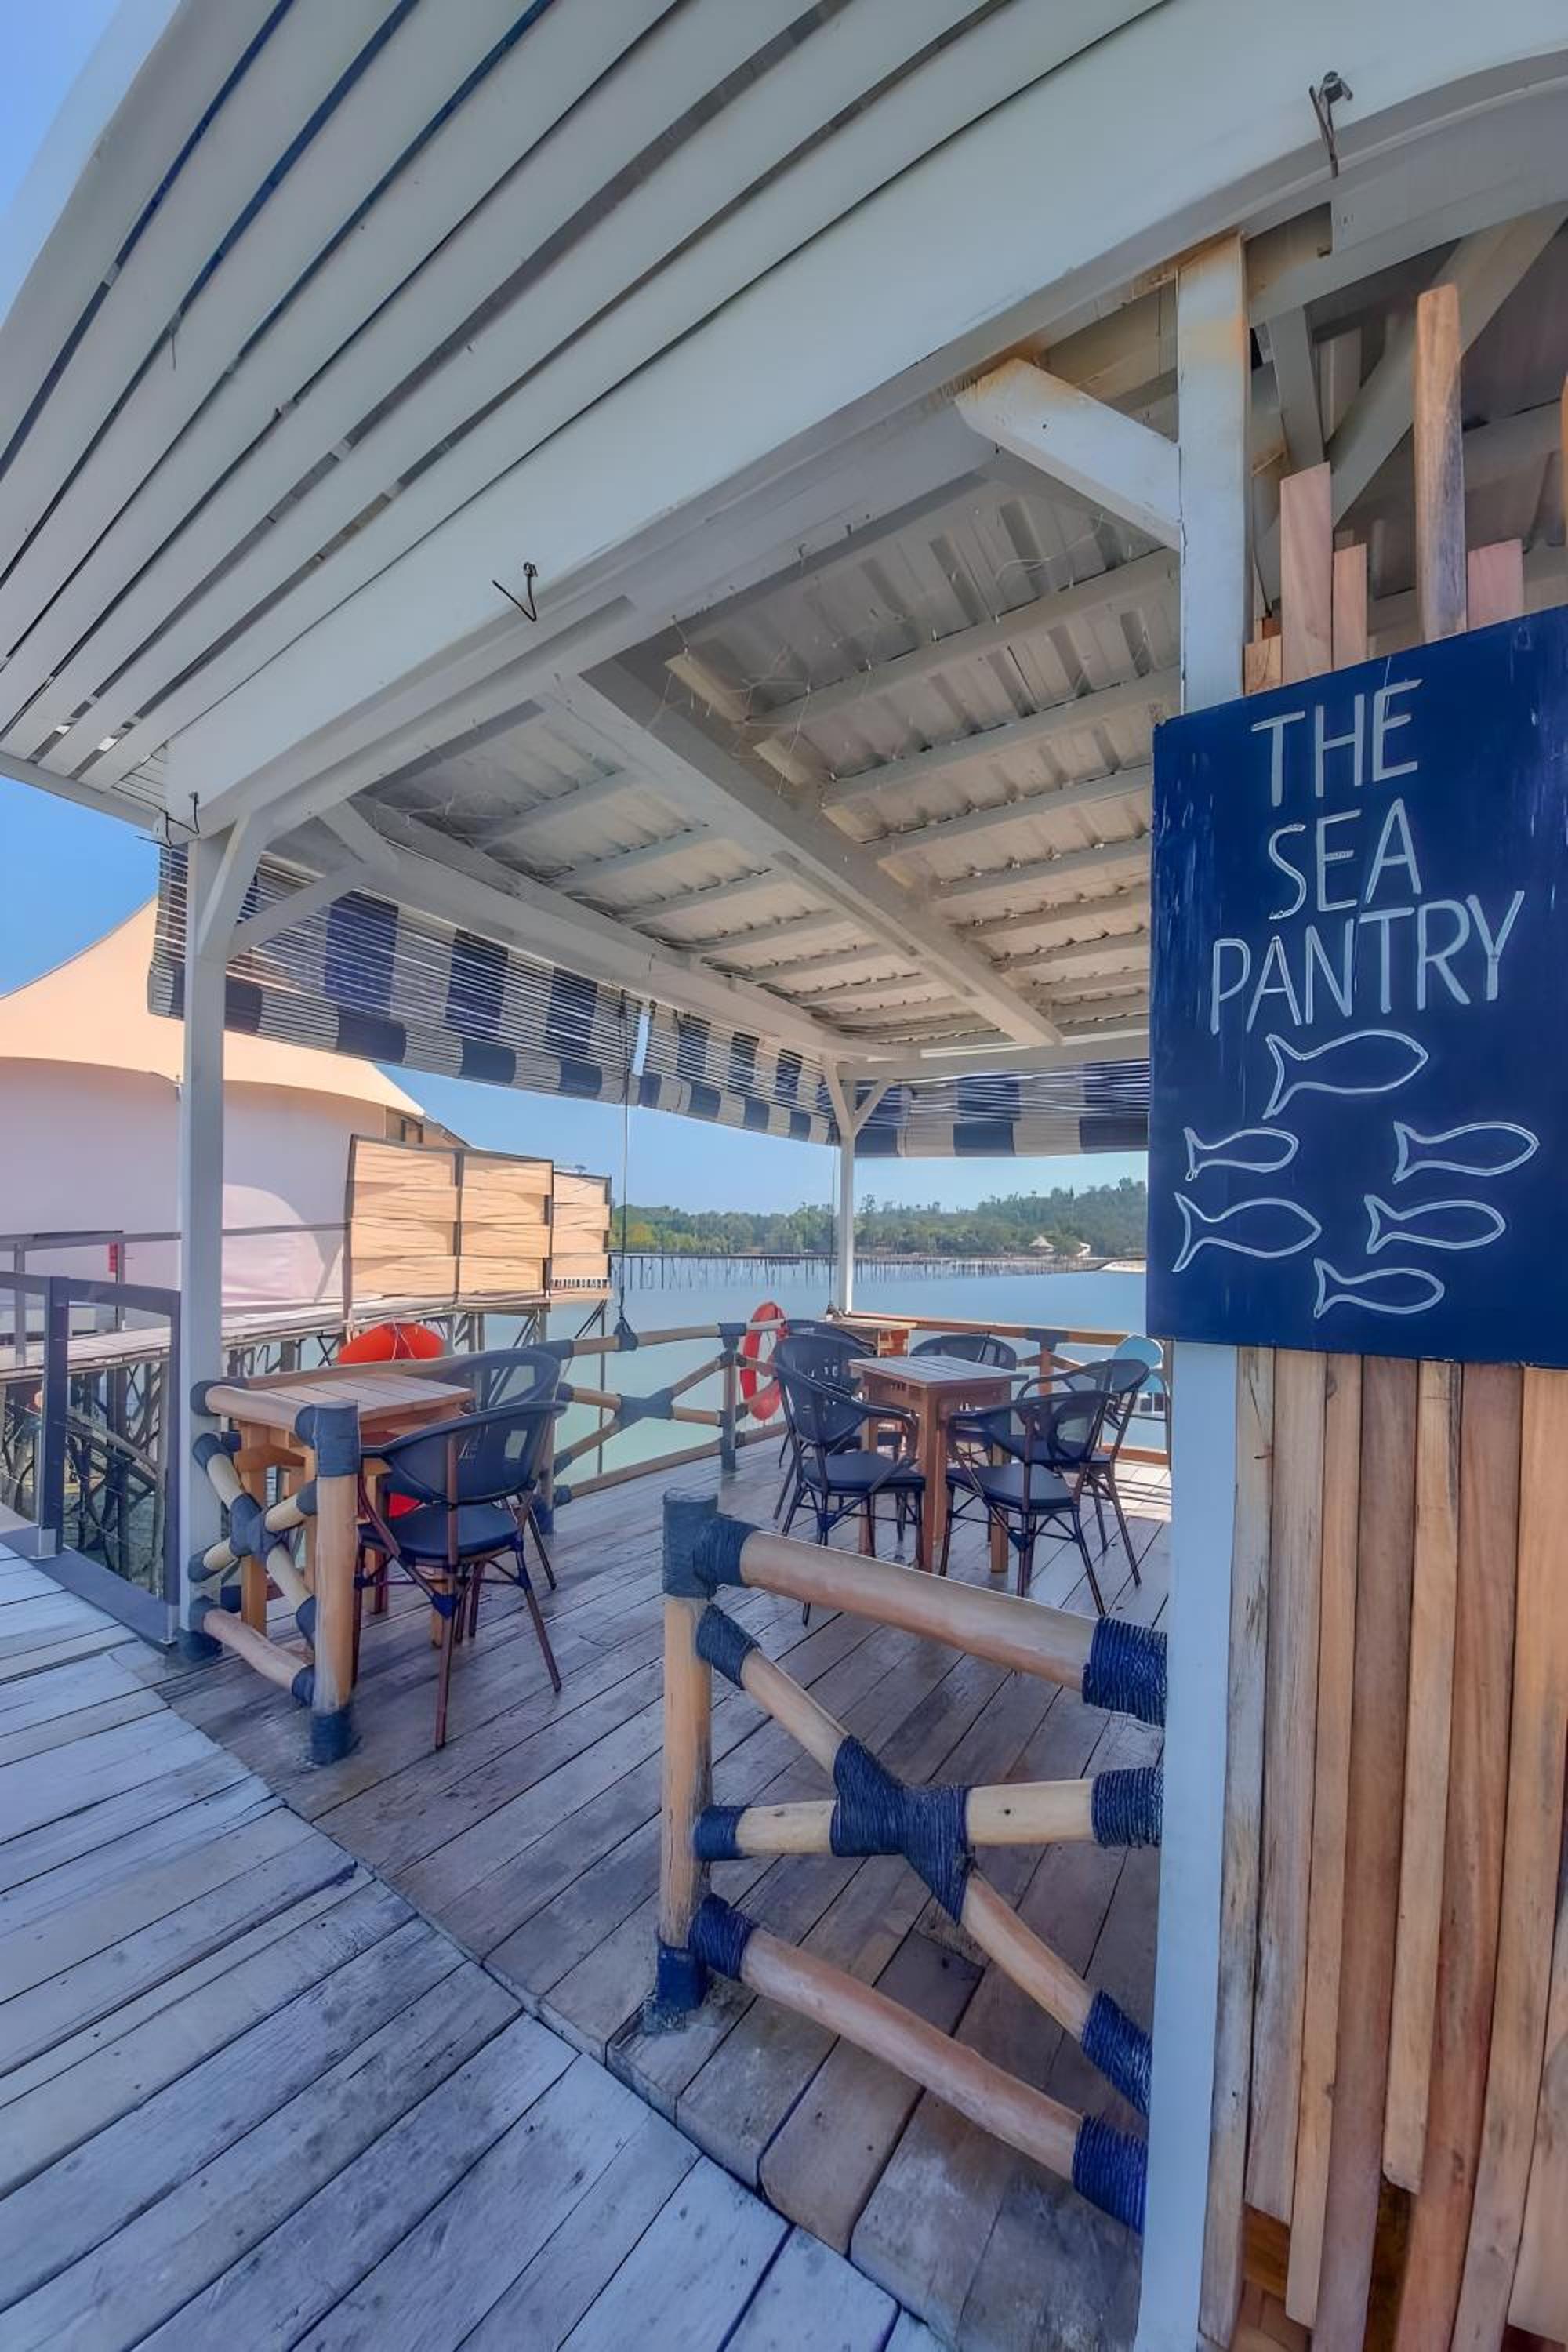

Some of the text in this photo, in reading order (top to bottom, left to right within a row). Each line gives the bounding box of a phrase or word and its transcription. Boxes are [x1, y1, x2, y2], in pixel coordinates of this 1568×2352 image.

[1251, 679, 1423, 807] THE
[1268, 798, 1422, 920] SEA
[1210, 890, 1525, 1034] PANTRY
